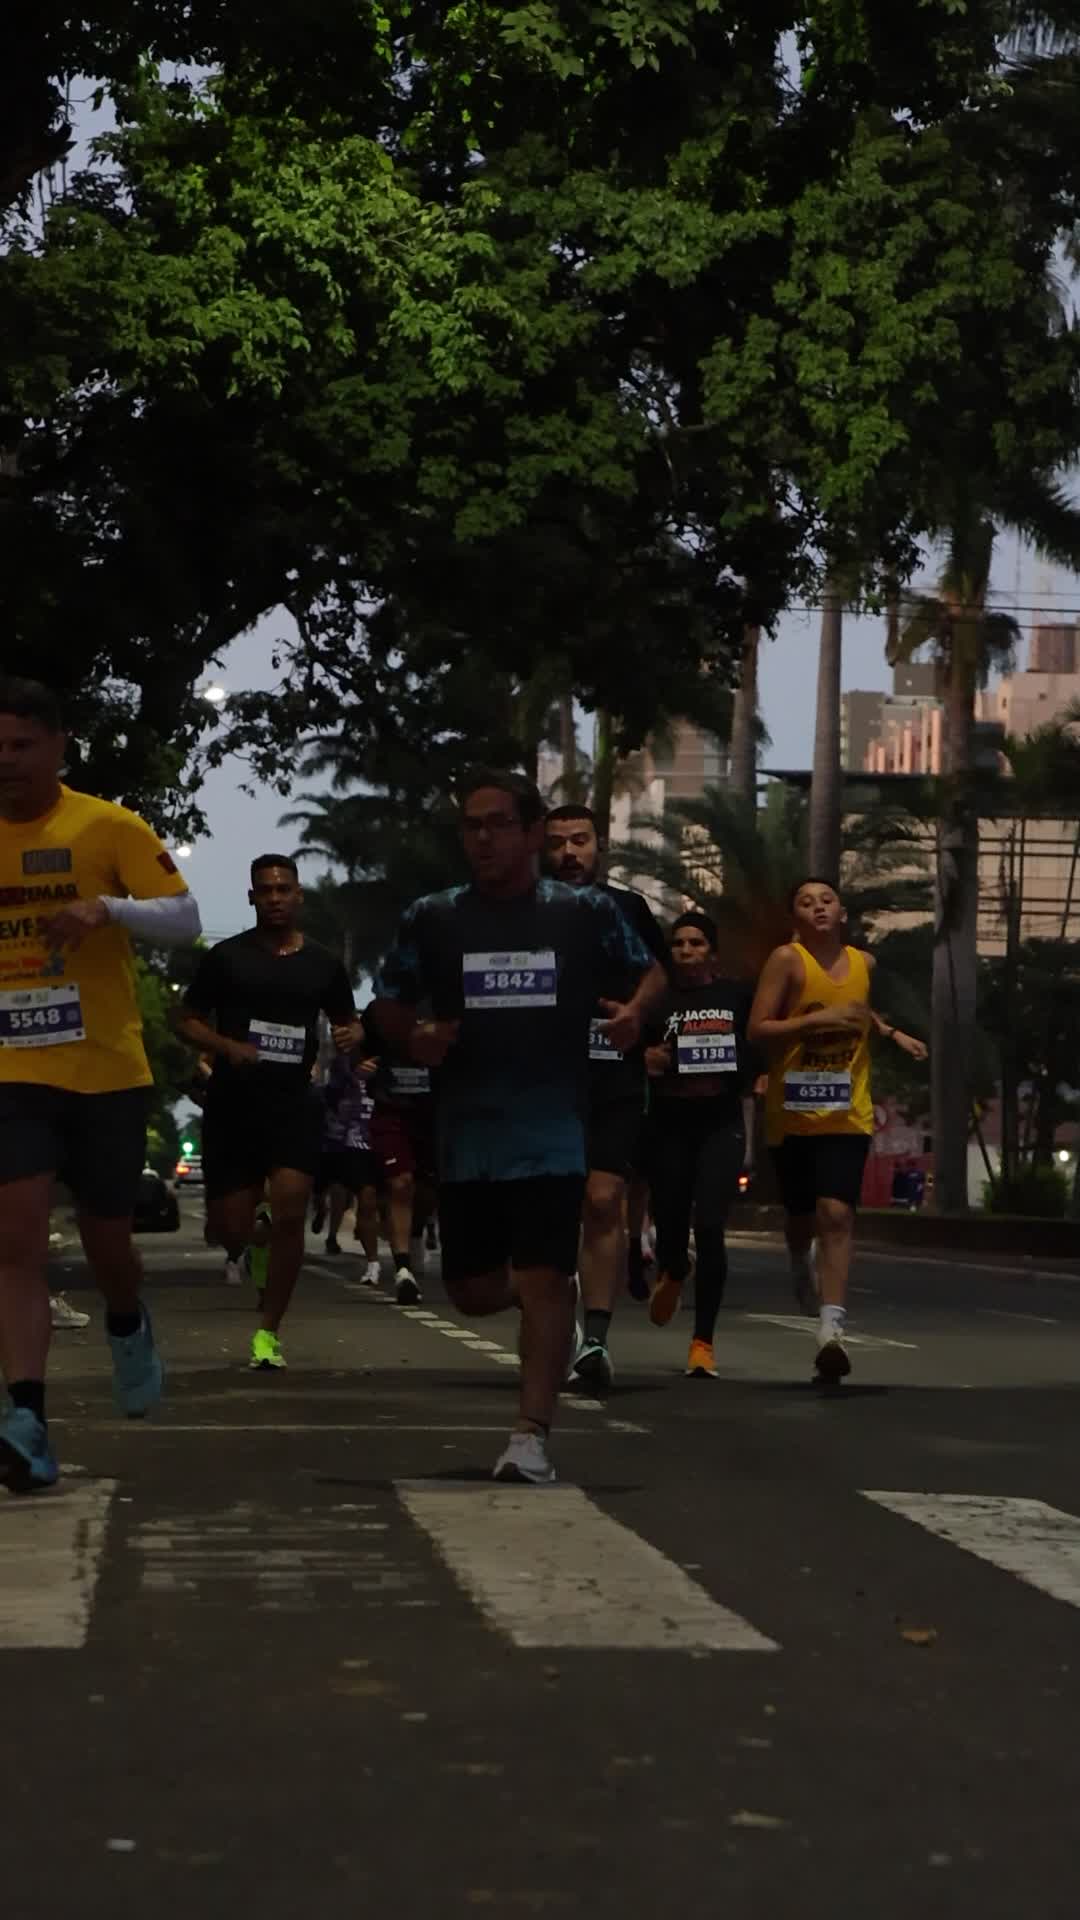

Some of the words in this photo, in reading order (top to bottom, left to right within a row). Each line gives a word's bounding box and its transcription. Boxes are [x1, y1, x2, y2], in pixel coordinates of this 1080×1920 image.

[483, 971, 536, 990] 5842
[9, 1007, 61, 1029] 5548
[683, 1009, 734, 1021] JACQUES
[260, 1035, 294, 1051] 5085
[691, 1047, 725, 1060] 5138
[799, 1085, 835, 1098] 6521
